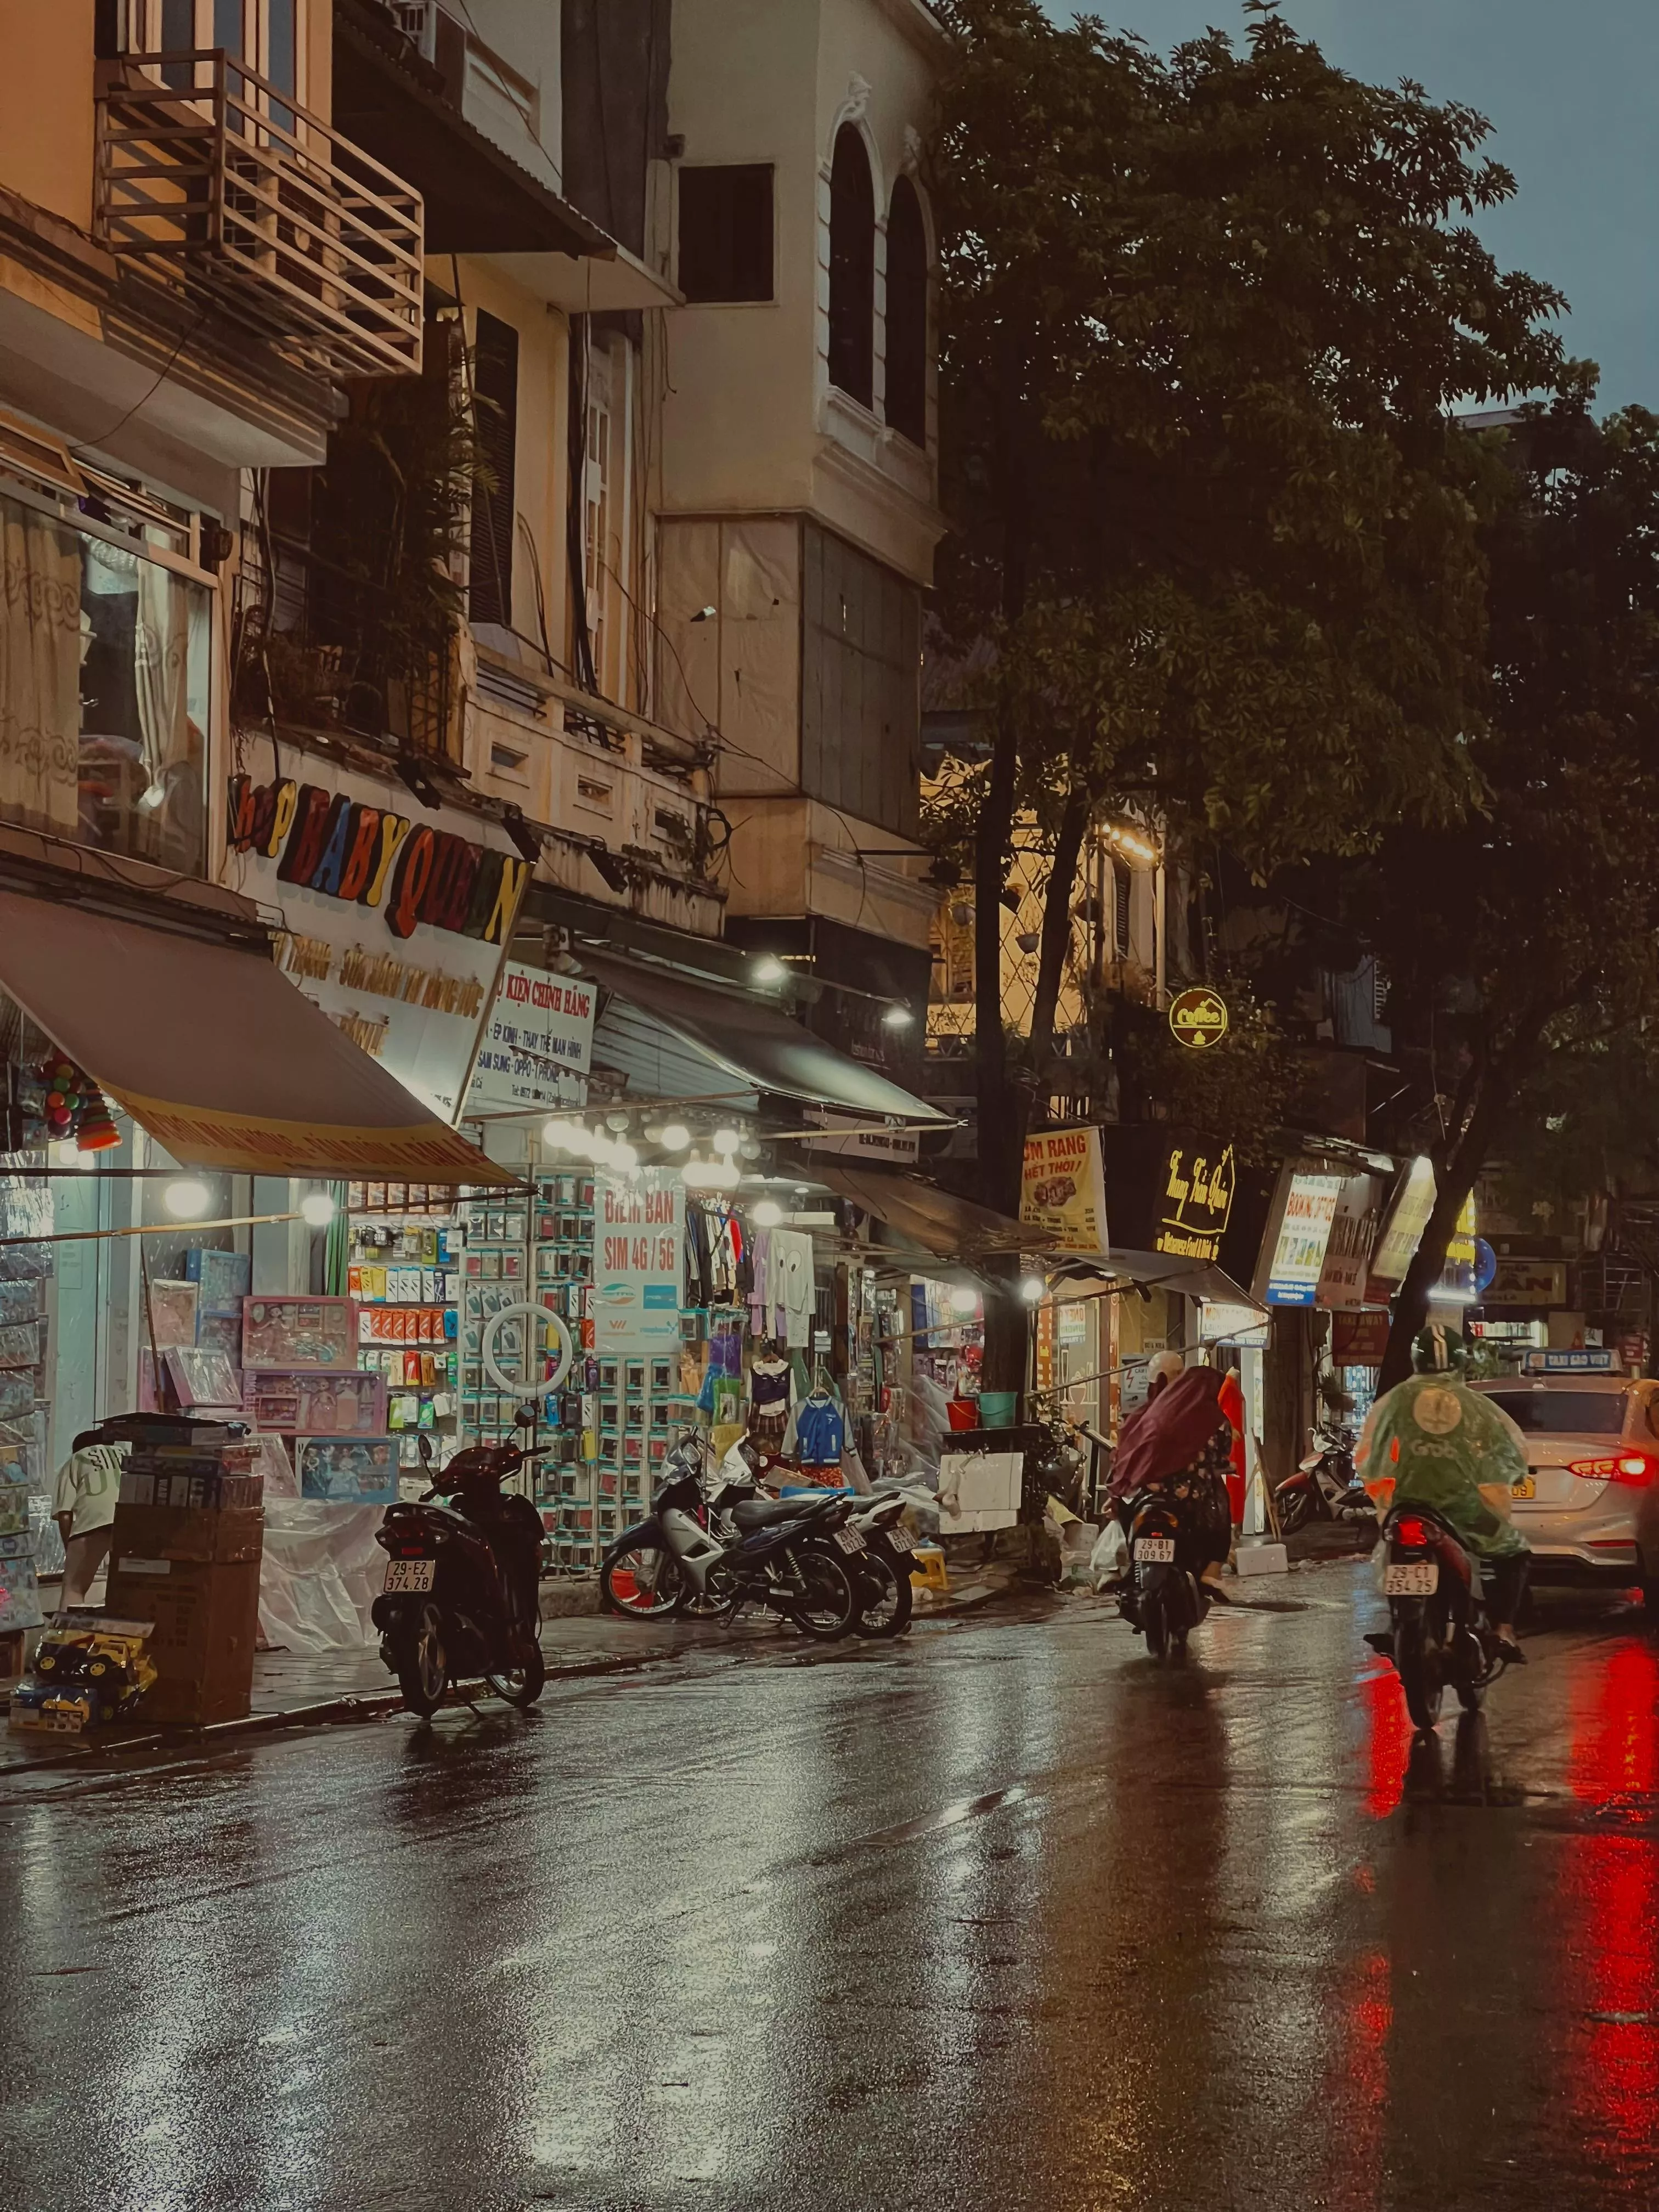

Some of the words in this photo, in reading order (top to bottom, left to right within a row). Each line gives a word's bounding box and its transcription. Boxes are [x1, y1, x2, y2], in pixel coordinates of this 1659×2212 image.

[277, 784, 410, 908] BABY
[1177, 1007, 1220, 1025] Coffee
[515, 1059, 532, 1077] OPPO
[1047, 1135, 1086, 1158] RANG
[604, 1237, 628, 1271] SIM
[632, 1237, 647, 1271] 4G
[659, 1237, 674, 1271] 5G
[1409, 1439, 1458, 1460] Grab
[393, 1562, 427, 1576] 29-E2
